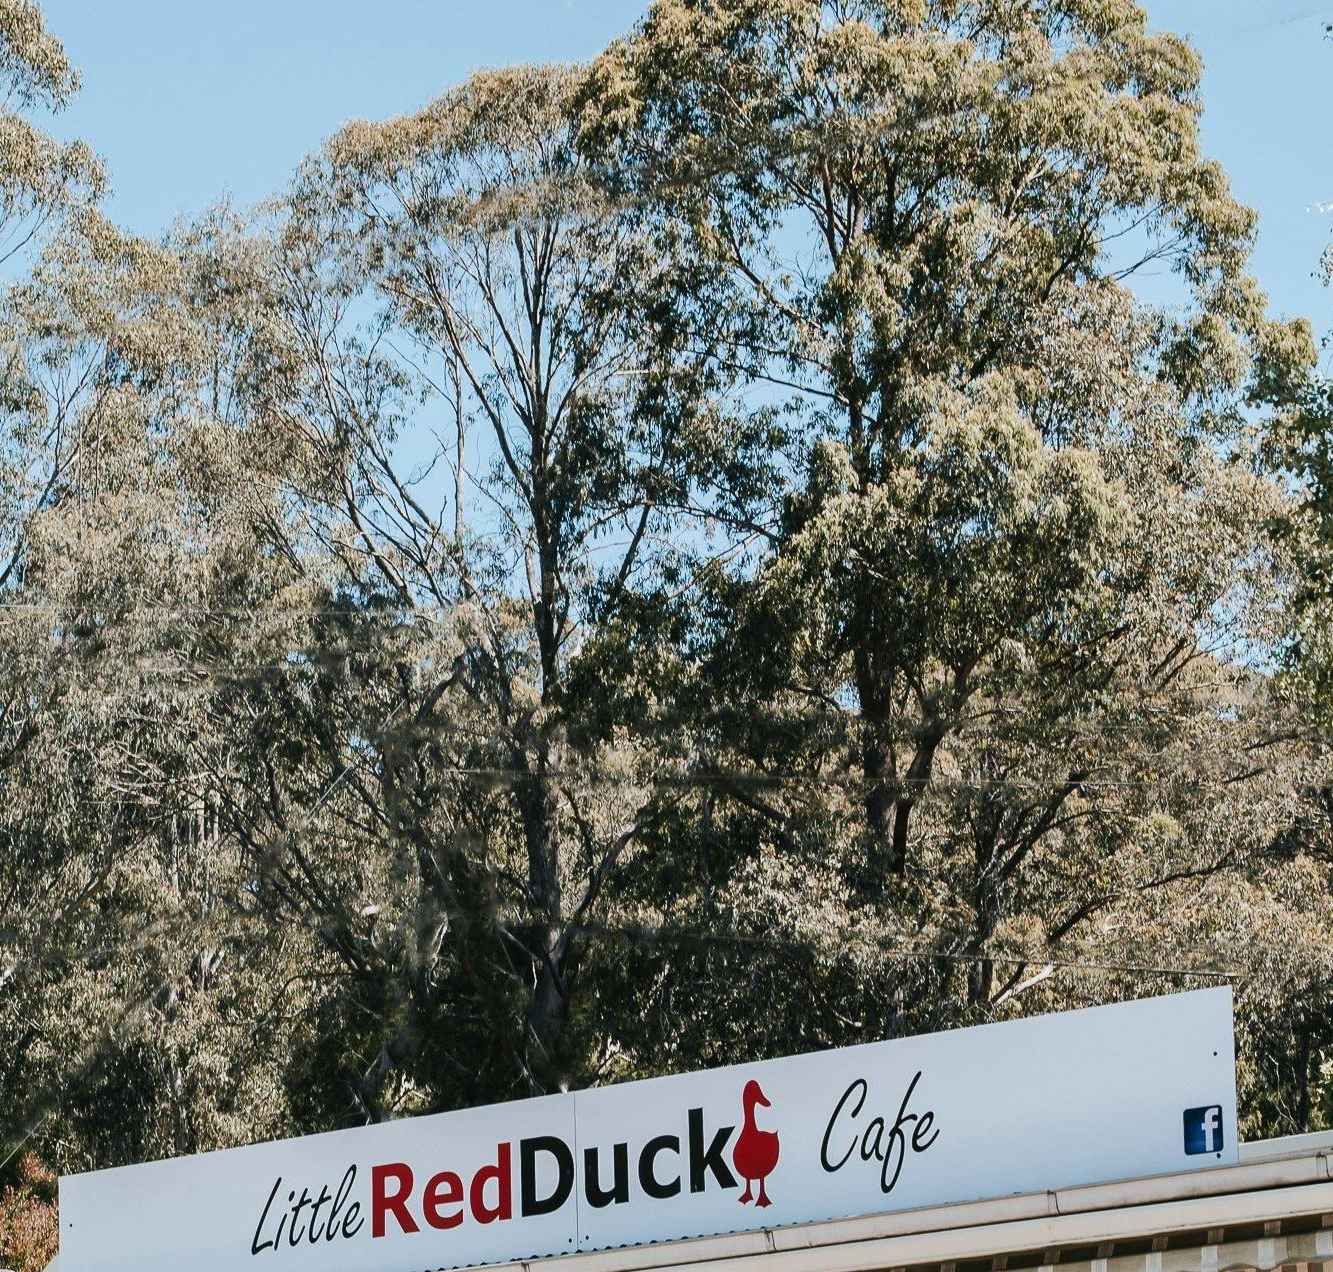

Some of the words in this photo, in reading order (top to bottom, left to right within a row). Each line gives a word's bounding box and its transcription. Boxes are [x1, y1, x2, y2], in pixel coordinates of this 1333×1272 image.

[251, 1163, 364, 1256] Little
[371, 1107, 739, 1238] RedDuck
[820, 1070, 941, 1194] Cafe
